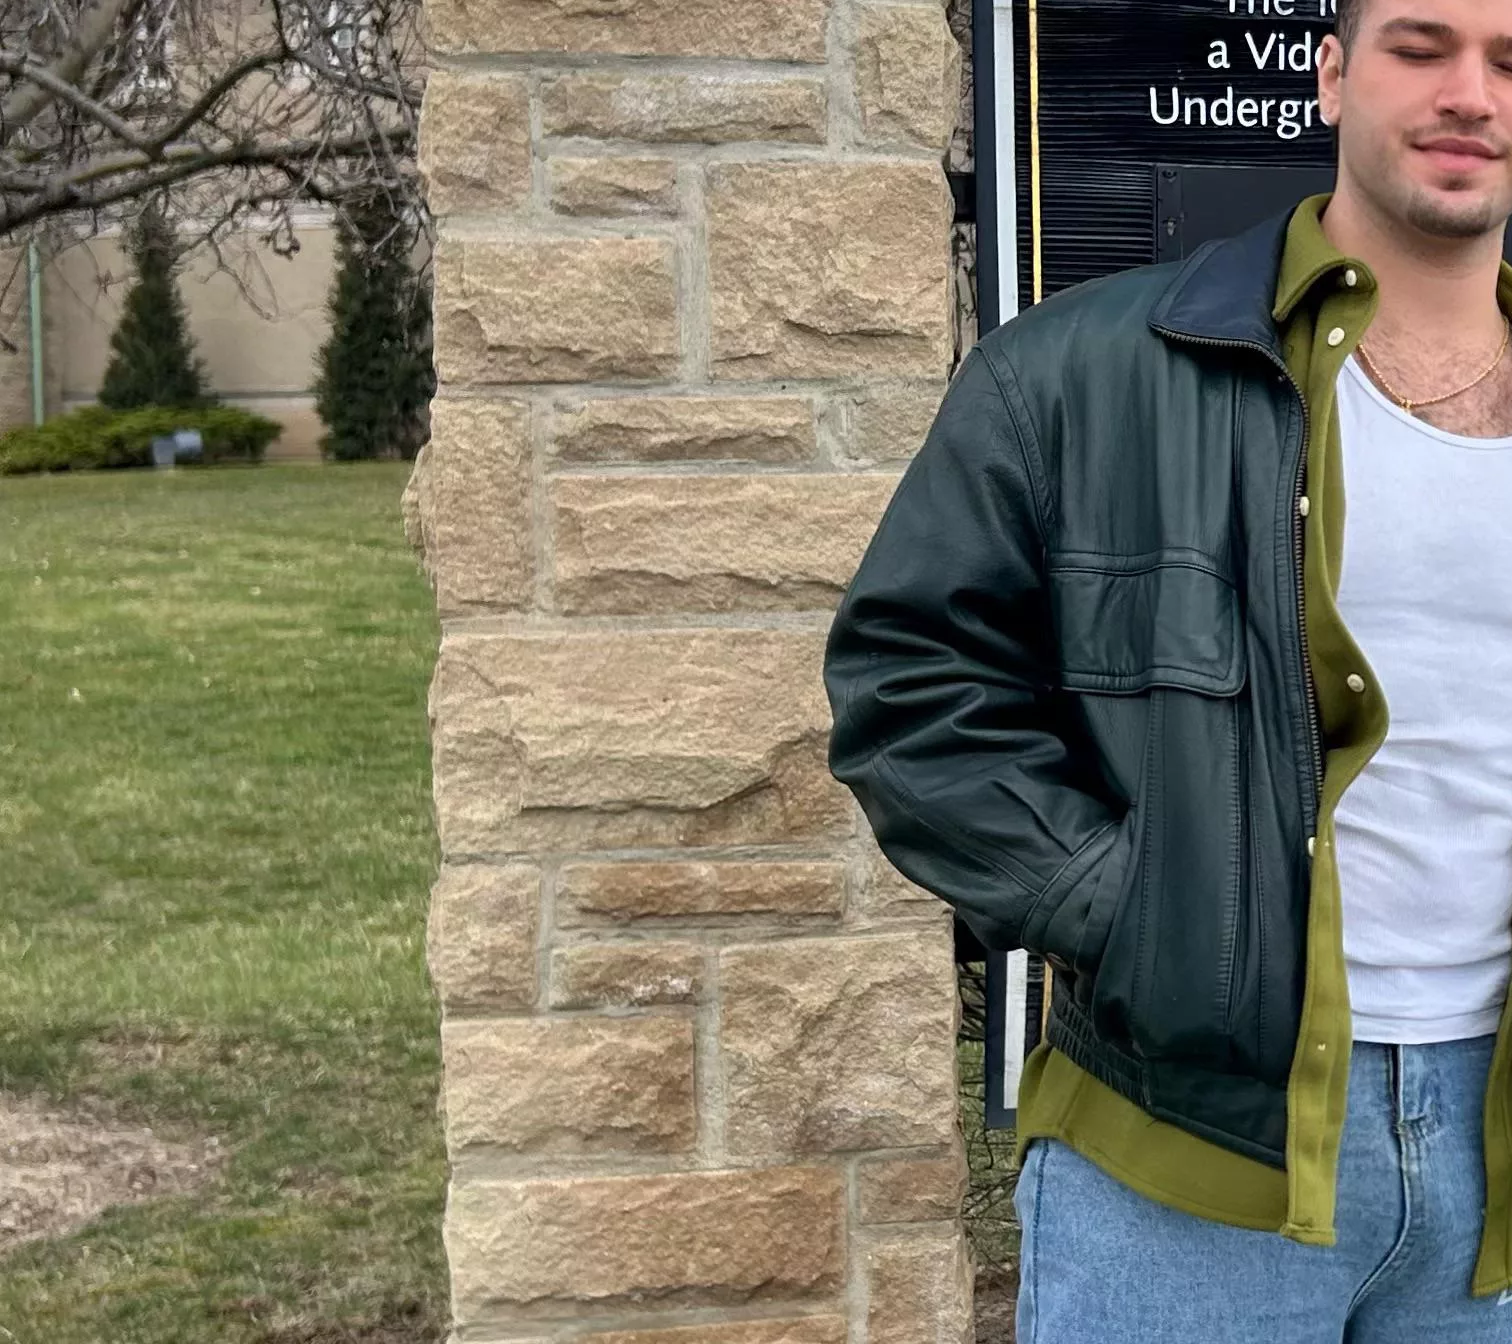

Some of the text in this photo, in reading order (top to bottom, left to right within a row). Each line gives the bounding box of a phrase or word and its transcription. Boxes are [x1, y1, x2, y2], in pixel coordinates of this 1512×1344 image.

[1207, 40, 1231, 69] a
[1244, 31, 1321, 71] Vid
[1149, 86, 1326, 140] Undergr
